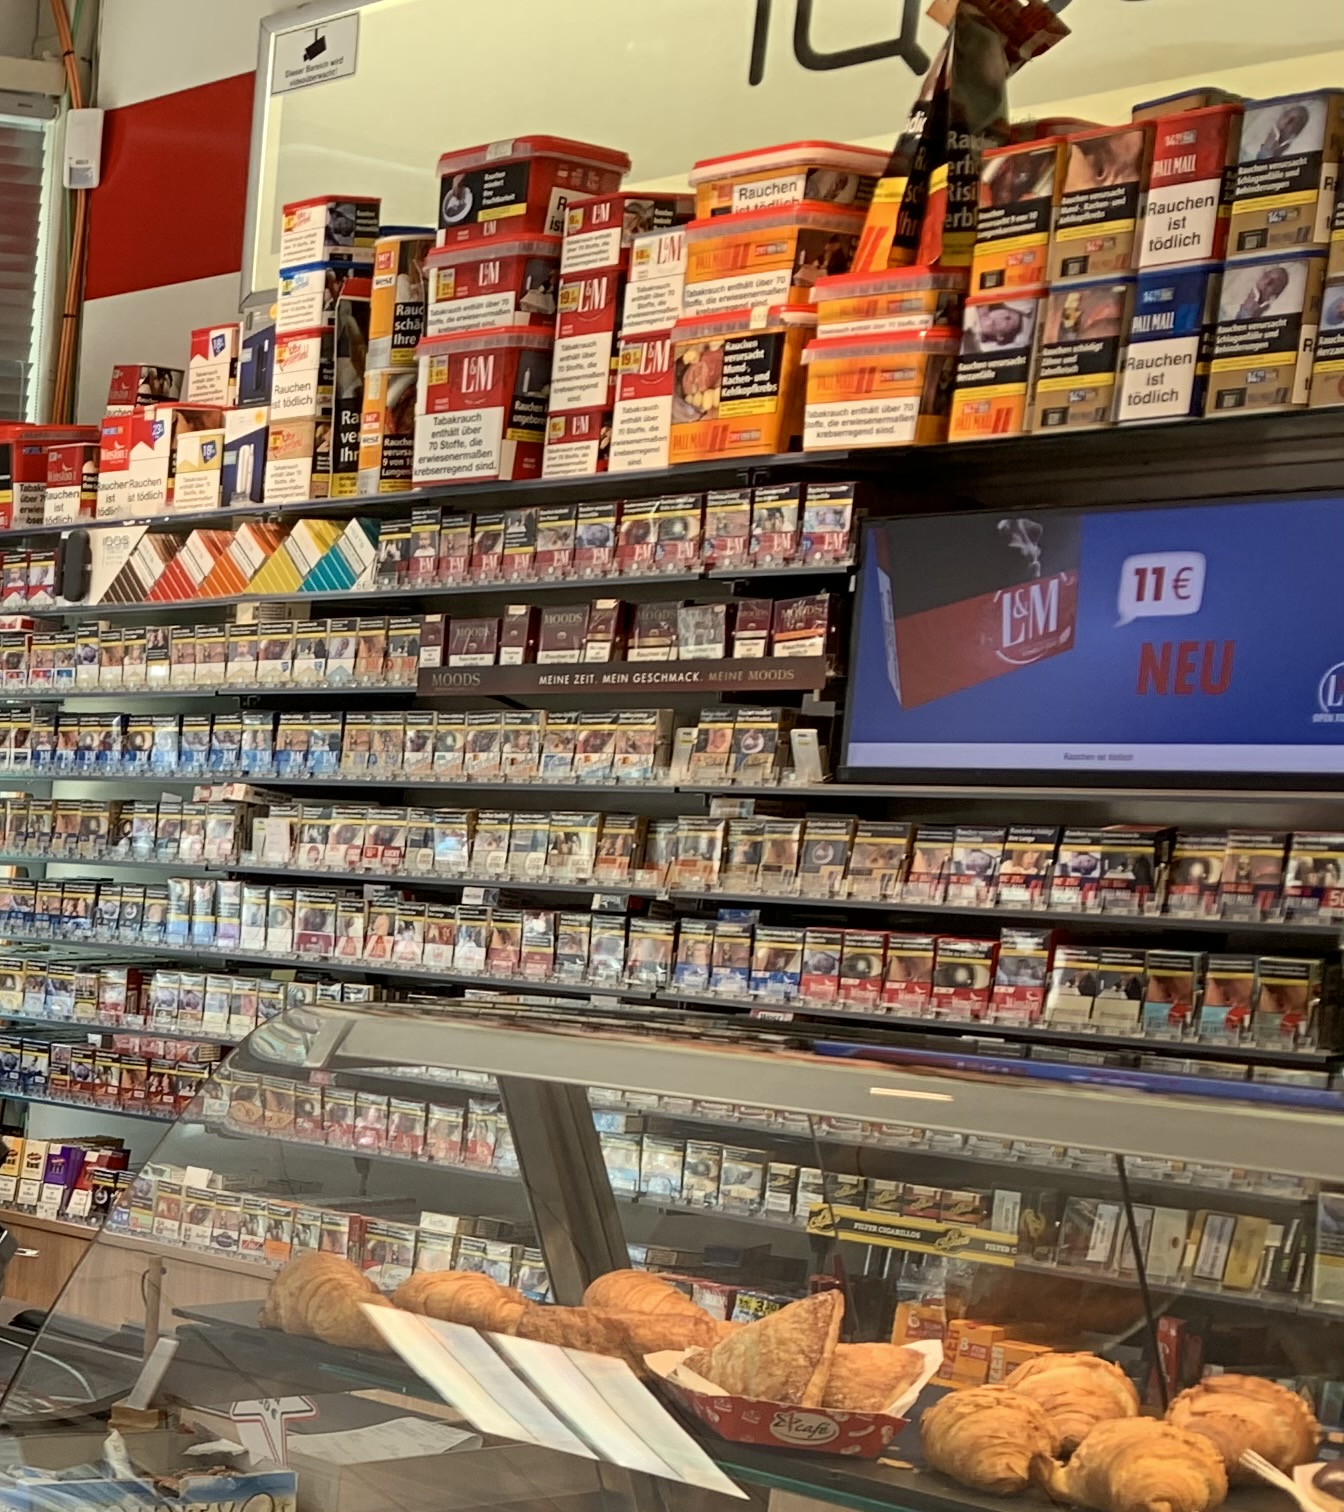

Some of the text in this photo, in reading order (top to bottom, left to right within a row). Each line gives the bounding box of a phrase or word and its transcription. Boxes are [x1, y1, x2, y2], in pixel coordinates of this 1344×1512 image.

[739, 181, 797, 200] Rauchen
[1148, 194, 1214, 216] Rauchen
[1168, 216, 1186, 231] ist
[1149, 232, 1201, 252] tödlich
[776, 276, 785, 285] 70
[578, 278, 607, 312] L&M
[1132, 312, 1174, 333] PALL MALL
[1126, 353, 1192, 370] Rauchen
[461, 354, 494, 394] L&M
[1147, 372, 1164, 386] ist
[282, 396, 313, 408] tödlich
[1128, 389, 1179, 405] tödlich
[904, 403, 914, 412] 70
[433, 414, 482, 426] Tabakrauch
[431, 425, 481, 440] enthält über
[429, 438, 483, 451] 70 Stoffe, die
[418, 450, 493, 464] erwiesenermaßen
[414, 461, 496, 476] krebserregend sind.
[138, 489, 163, 502] tödlich
[54, 503, 65, 513] ist
[1134, 566, 1194, 602] 11 €
[997, 578, 1060, 649] L&M
[1137, 640, 1235, 696] NEU
[431, 669, 795, 687] MOODS MEINE ZEIT. MEIN GESCHMACK. MEINE MOODS
[794, 1421, 830, 1434] café
